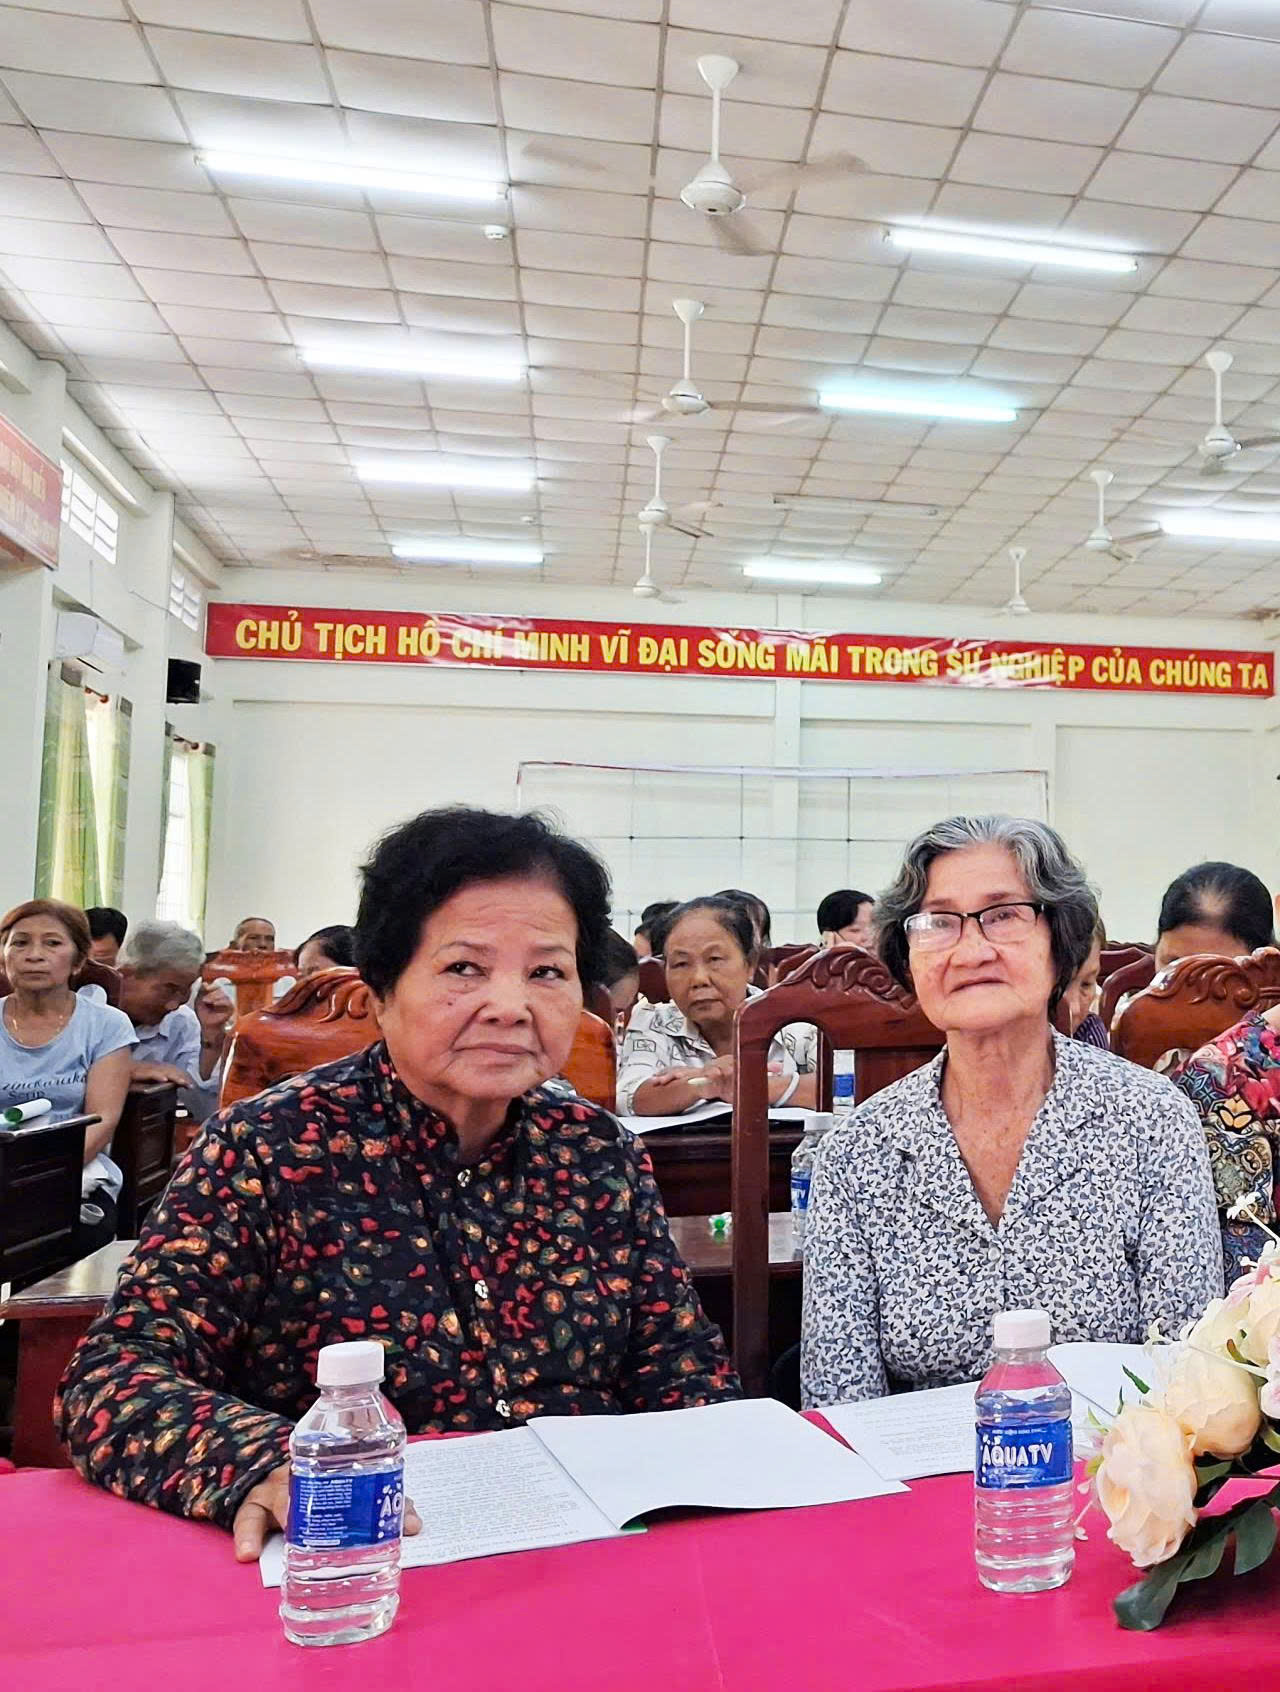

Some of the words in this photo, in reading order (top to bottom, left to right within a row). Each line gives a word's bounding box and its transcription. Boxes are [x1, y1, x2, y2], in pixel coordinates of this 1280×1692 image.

[235, 610, 302, 651] CHỦ
[314, 622, 387, 660] TỊCH
[397, 615, 441, 658] HỒ
[451, 624, 503, 660] CHÍ
[513, 630, 590, 663] MINH
[600, 628, 632, 664] VĨ
[637, 636, 689, 672] ĐẠI
[698, 629, 776, 671] SỐNG
[786, 637, 839, 673] MÃI
[847, 645, 938, 677] TRONG
[991, 647, 1086, 686] NGHIỆP
[1091, 647, 1143, 685] CỦA
[1150, 654, 1232, 688] CHÚNG
[1237, 662, 1269, 689] TA
[982, 1442, 1053, 1467] AQUATV
